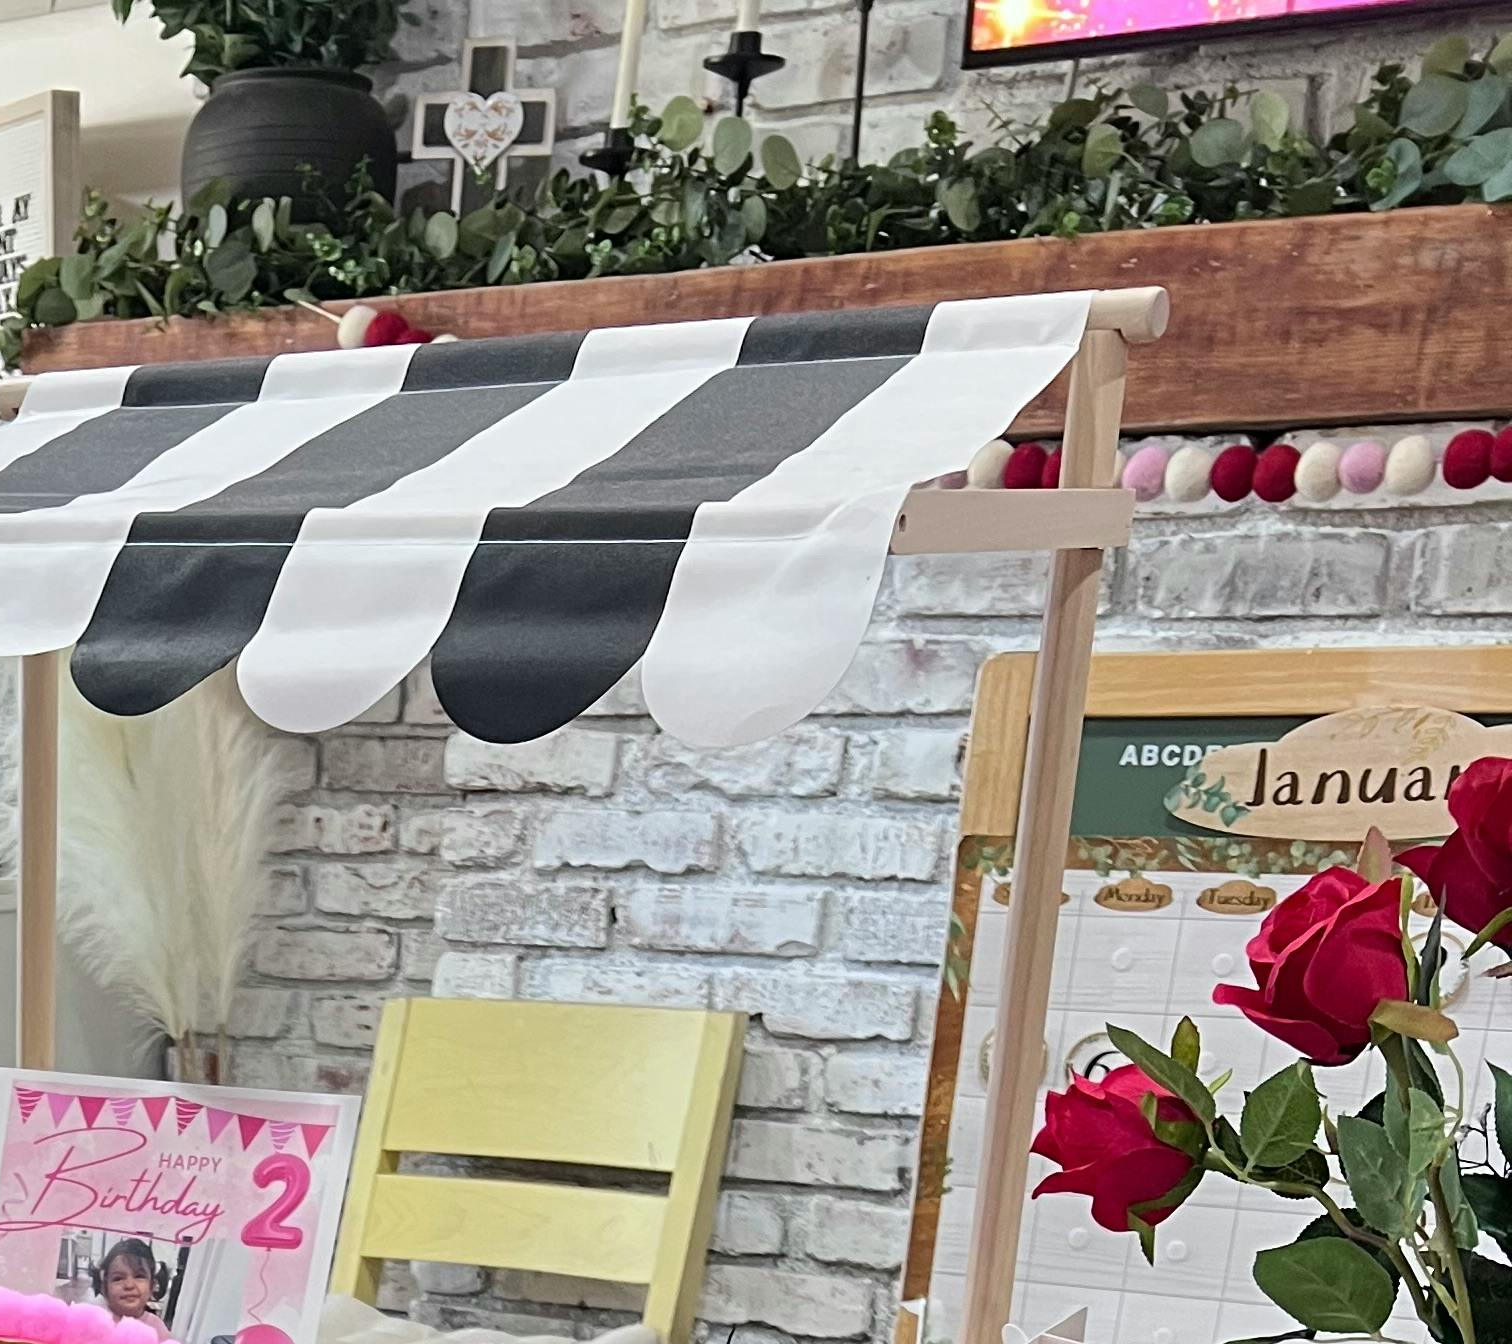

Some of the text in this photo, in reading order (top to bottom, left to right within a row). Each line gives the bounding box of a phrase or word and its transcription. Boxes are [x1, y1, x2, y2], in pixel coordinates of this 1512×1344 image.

[1104, 888, 1269, 911] Monday Tuesday
[157, 1152, 223, 1174] HAPPY
[240, 1153, 312, 1250] 2
